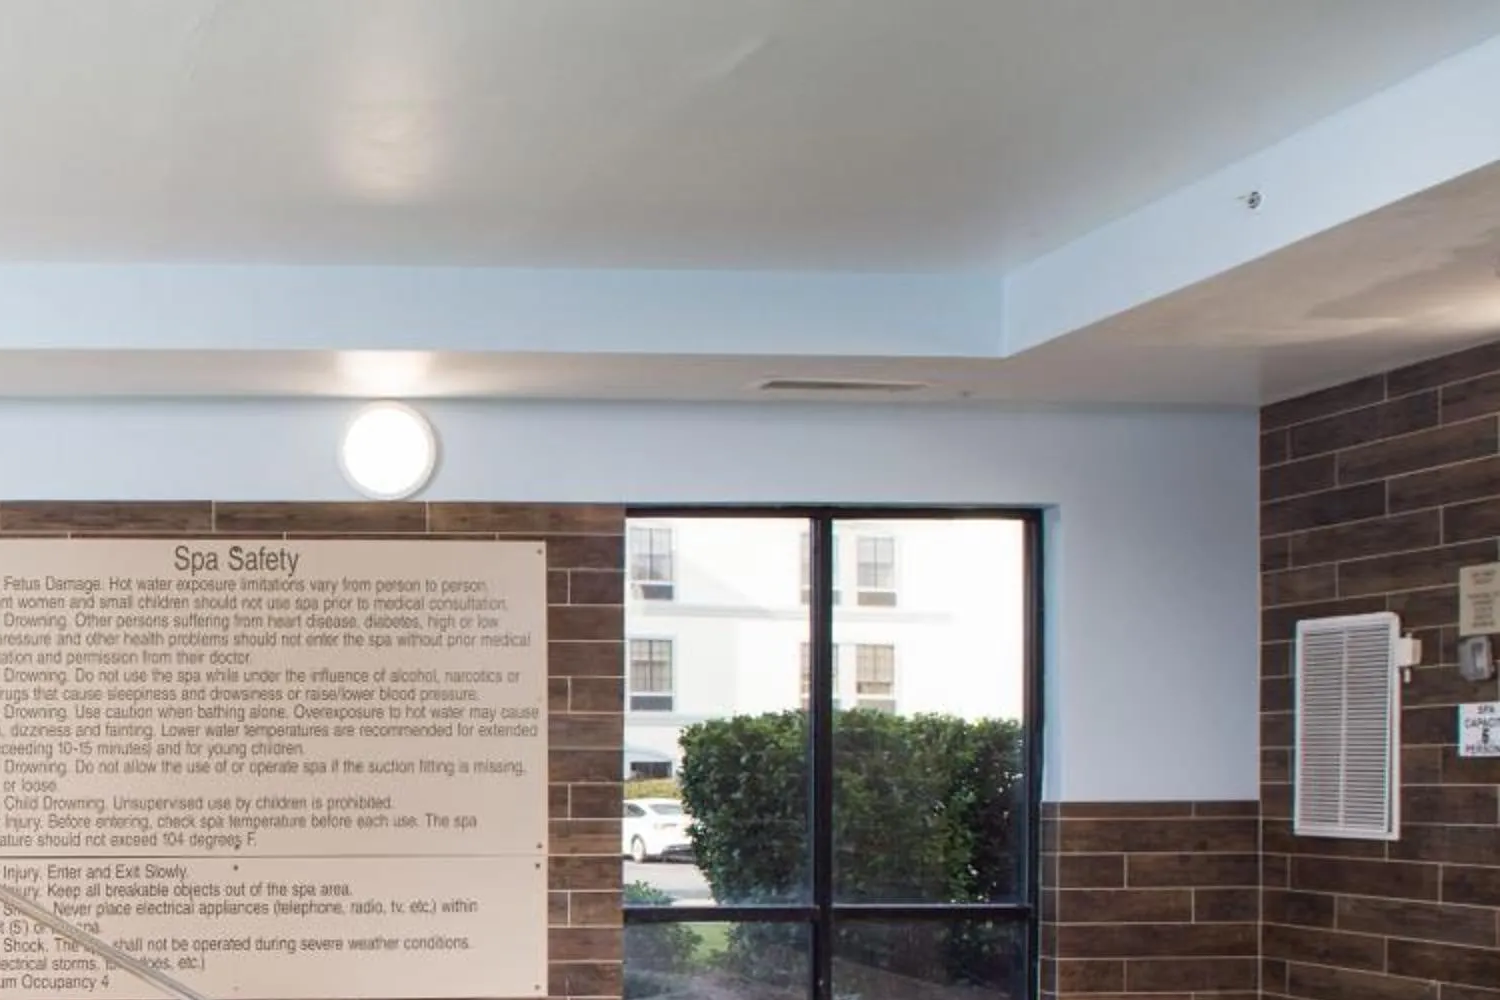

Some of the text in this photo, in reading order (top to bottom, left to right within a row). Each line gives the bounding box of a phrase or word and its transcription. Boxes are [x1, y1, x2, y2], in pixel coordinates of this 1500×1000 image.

[174, 545, 299, 577] Spa Safety
[4, 576, 40, 590] Fetus
[109, 577, 132, 591] Hot
[136, 577, 173, 591] water
[176, 580, 237, 595] exposure
[310, 580, 338, 595] vary
[375, 581, 420, 596] person
[17, 597, 65, 608] women
[69, 594, 95, 608] and
[100, 595, 134, 609] small
[137, 595, 189, 609] children
[194, 595, 237, 609] should
[241, 596, 263, 610] not
[295, 598, 319, 613] spa
[323, 596, 353, 614] prior
[74, 614, 113, 628] Other
[116, 616, 169, 631] persons
[85, 632, 120, 646] other
[123, 632, 164, 646] health
[168, 632, 228, 650] problems
[234, 632, 277, 646] should
[142, 650, 172, 664] from
[176, 650, 204, 664] their
[75, 668, 94, 682] Do
[177, 671, 201, 686] spa
[206, 669, 239, 683] while
[244, 669, 281, 683] under
[285, 669, 306, 683] the
[32, 686, 59, 700] that
[62, 689, 103, 700] cause
[379, 687, 416, 701] blood
[74, 705, 101, 719] Use
[105, 705, 153, 719] caution
[157, 705, 193, 719] when
[197, 705, 245, 722] bathing
[429, 705, 465, 719] water
[469, 708, 496, 723] may
[500, 708, 539, 719] cause
[161, 723, 201, 737] Lower
[333, 726, 356, 737] are
[478, 723, 538, 737] extended
[156, 741, 181, 755] and
[185, 741, 203, 755] for
[207, 743, 247, 758] young
[75, 759, 414, 777] Do allow operate spa the suction
[4, 796, 39, 810] Child
[236, 796, 252, 814] by
[255, 796, 307, 810] children
[48, 814, 91, 828] Before
[157, 814, 197, 828] check
[311, 814, 352, 828] before
[427, 814, 449, 828] The
[454, 817, 477, 832] spa
[36, 832, 81, 846] should
[110, 832, 158, 846] exceed
[189, 832, 243, 850] degrees
[47, 865, 82, 879] Enter
[85, 864, 111, 878] and
[115, 864, 140, 878] Exit
[145, 864, 188, 882] Slowly.
[47, 883, 81, 901] Keep
[85, 883, 101, 897] all
[173, 882, 221, 900] objects
[223, 882, 246, 896] out
[266, 882, 289, 896] the
[292, 884, 316, 899] spa
[50, 902, 92, 916] Never
[96, 901, 132, 919] place
[442, 899, 478, 913] within
[3, 939, 48, 953] Shock.
[110, 938, 143, 952] shall
[147, 938, 167, 952] not
[171, 938, 189, 952] be
[191, 938, 251, 955] operated
[255, 937, 297, 955] during
[299, 939, 344, 951] severe
[348, 936, 399, 950] weather
